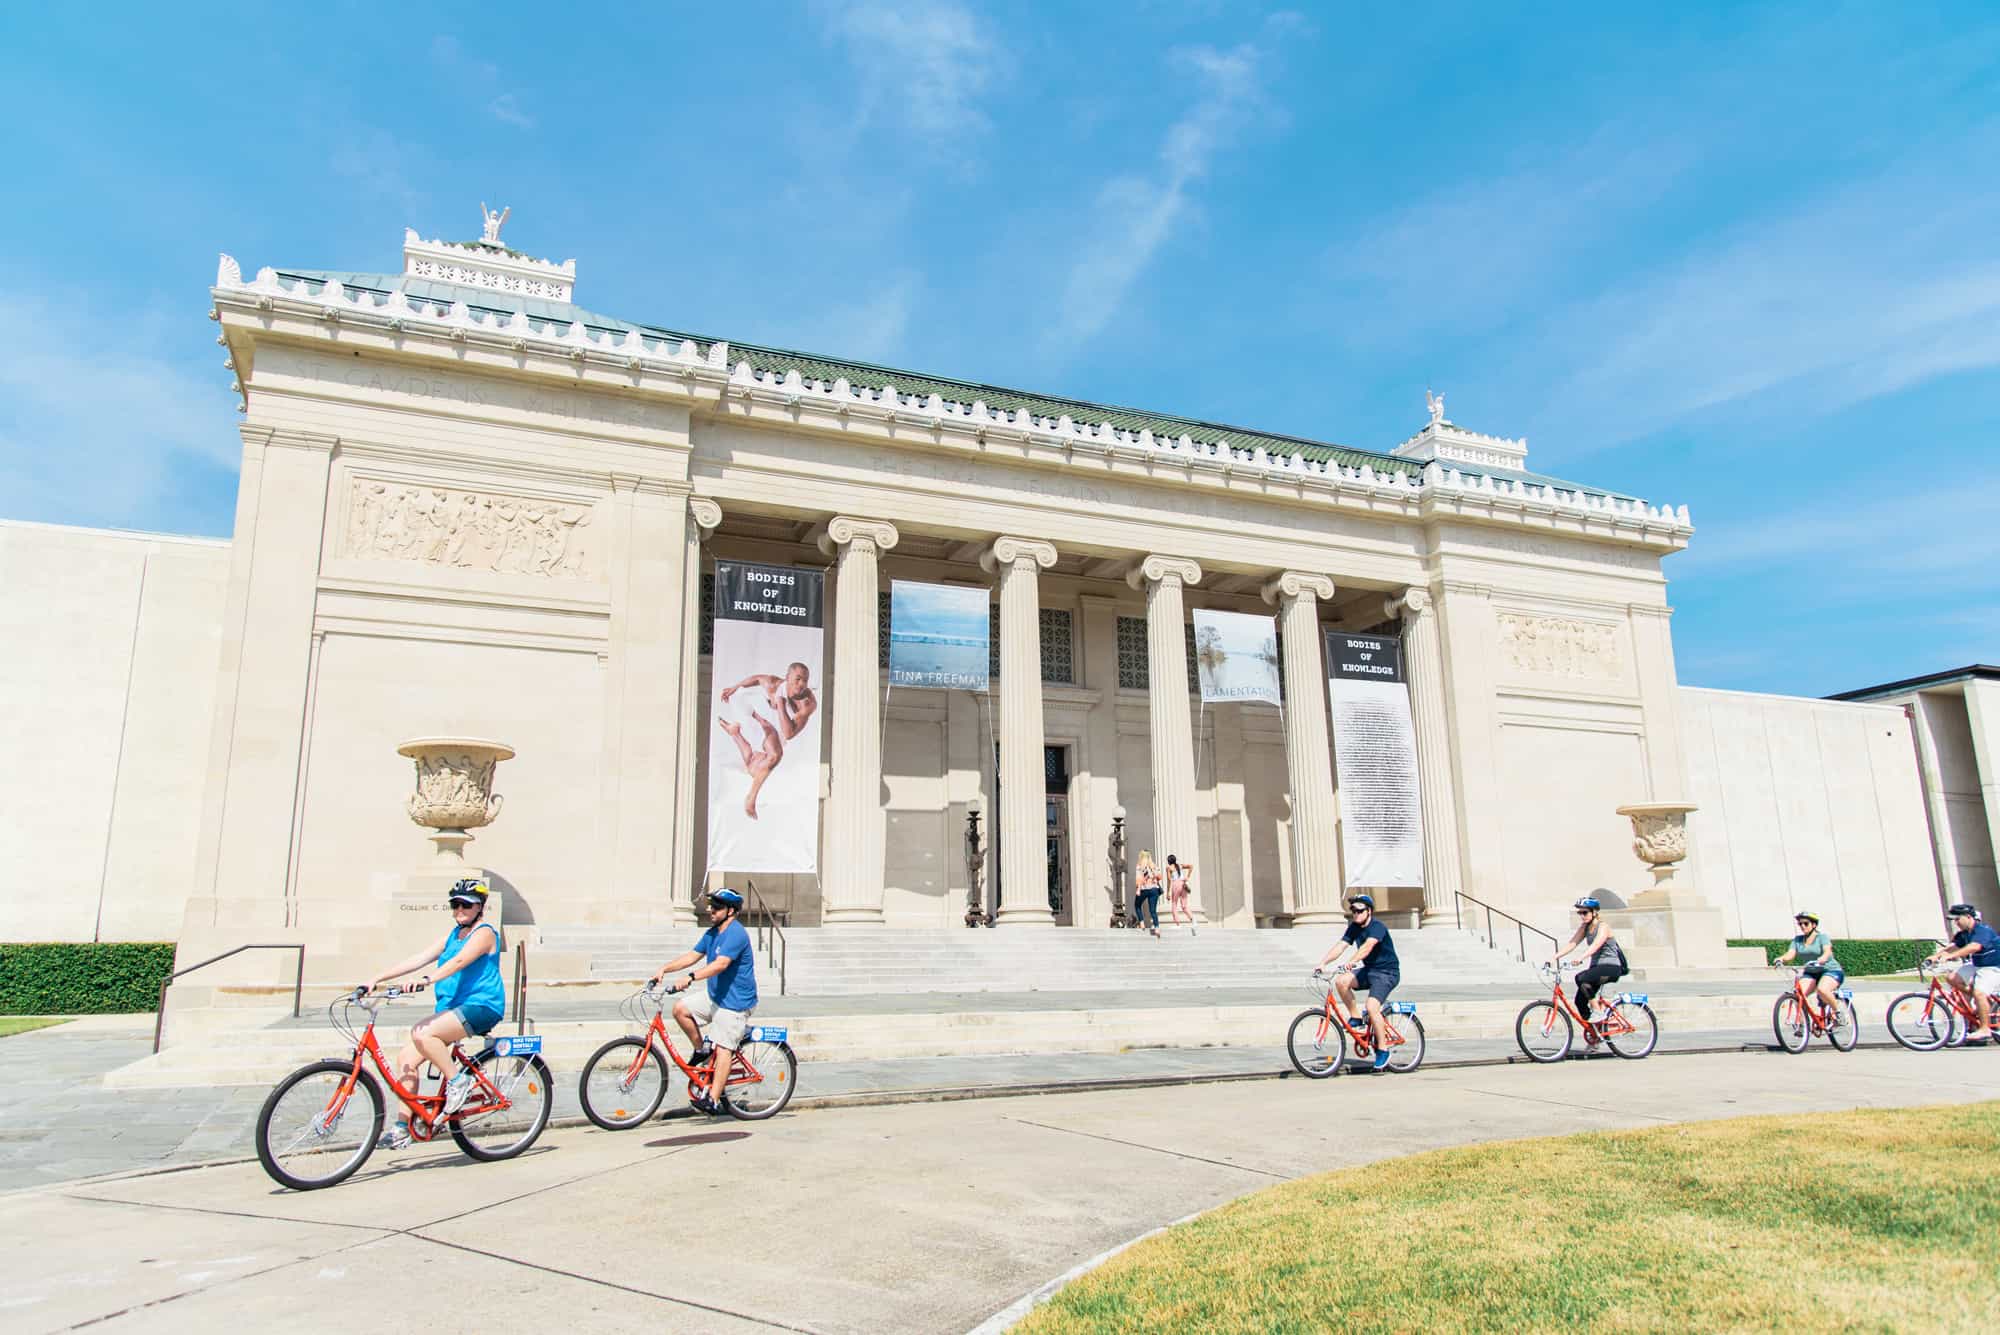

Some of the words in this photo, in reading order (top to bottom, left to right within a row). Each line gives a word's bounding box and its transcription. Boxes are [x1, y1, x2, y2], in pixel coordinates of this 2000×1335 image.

[747, 572, 795, 586] BODIES
[763, 588, 779, 599] OF
[734, 601, 807, 617] KNOWLEDGE
[1347, 640, 1381, 650] BODIES
[1360, 653, 1372, 661] OF
[1342, 664, 1394, 675] KNOWLEDGE
[893, 671, 922, 681] TINA
[928, 672, 984, 686] FREEMAN
